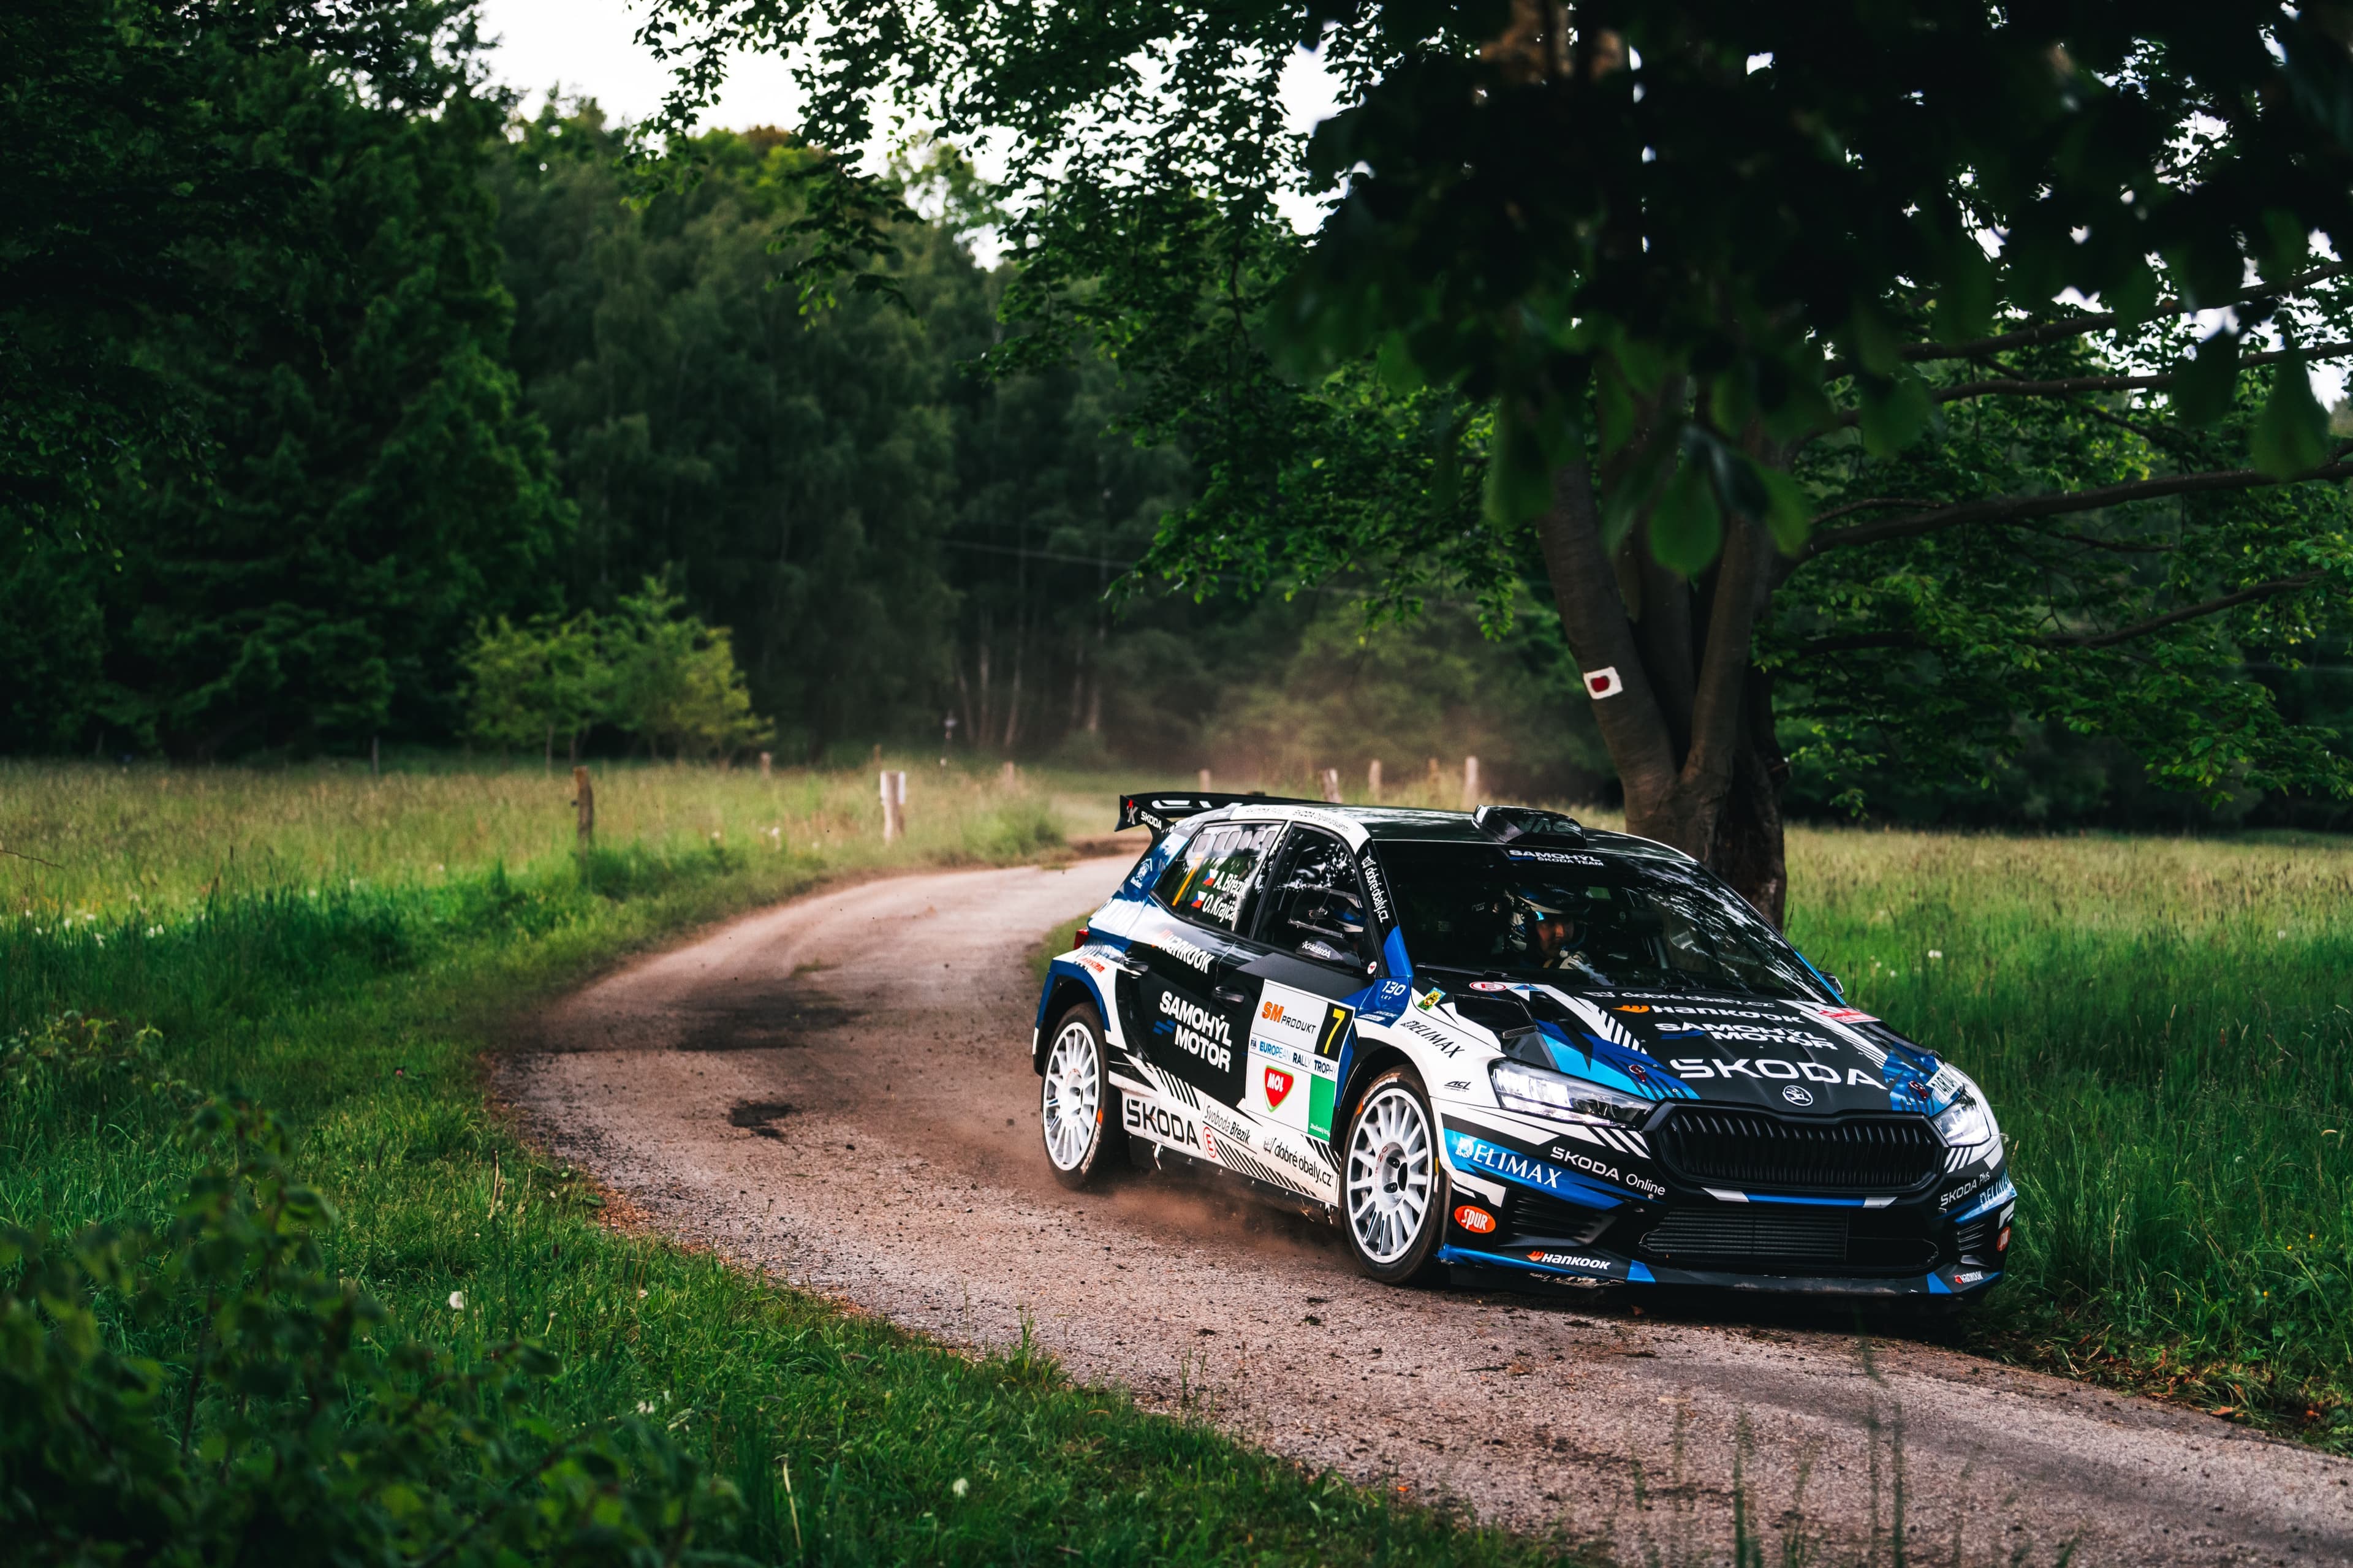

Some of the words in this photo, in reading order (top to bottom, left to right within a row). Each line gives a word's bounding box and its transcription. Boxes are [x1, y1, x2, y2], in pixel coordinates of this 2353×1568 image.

[1382, 980, 1406, 996] 130
[1159, 991, 1232, 1047] SAMOHÝL
[1261, 1001, 1284, 1023] SM
[1281, 1015, 1316, 1034] PRODUKT
[1324, 1008, 1346, 1055] 7
[1710, 1031, 1839, 1050] MOTOR
[1175, 1024, 1231, 1073] MOTOR
[1259, 1040, 1290, 1061] EUROPEAN
[1292, 1052, 1311, 1068] RALLY
[1314, 1059, 1337, 1077] TROPHY
[1267, 1072, 1284, 1093] MOL
[1205, 1105, 1230, 1132] Svoboda
[1626, 1173, 1665, 1195] Online
[1979, 1171, 1990, 1186] Plus
